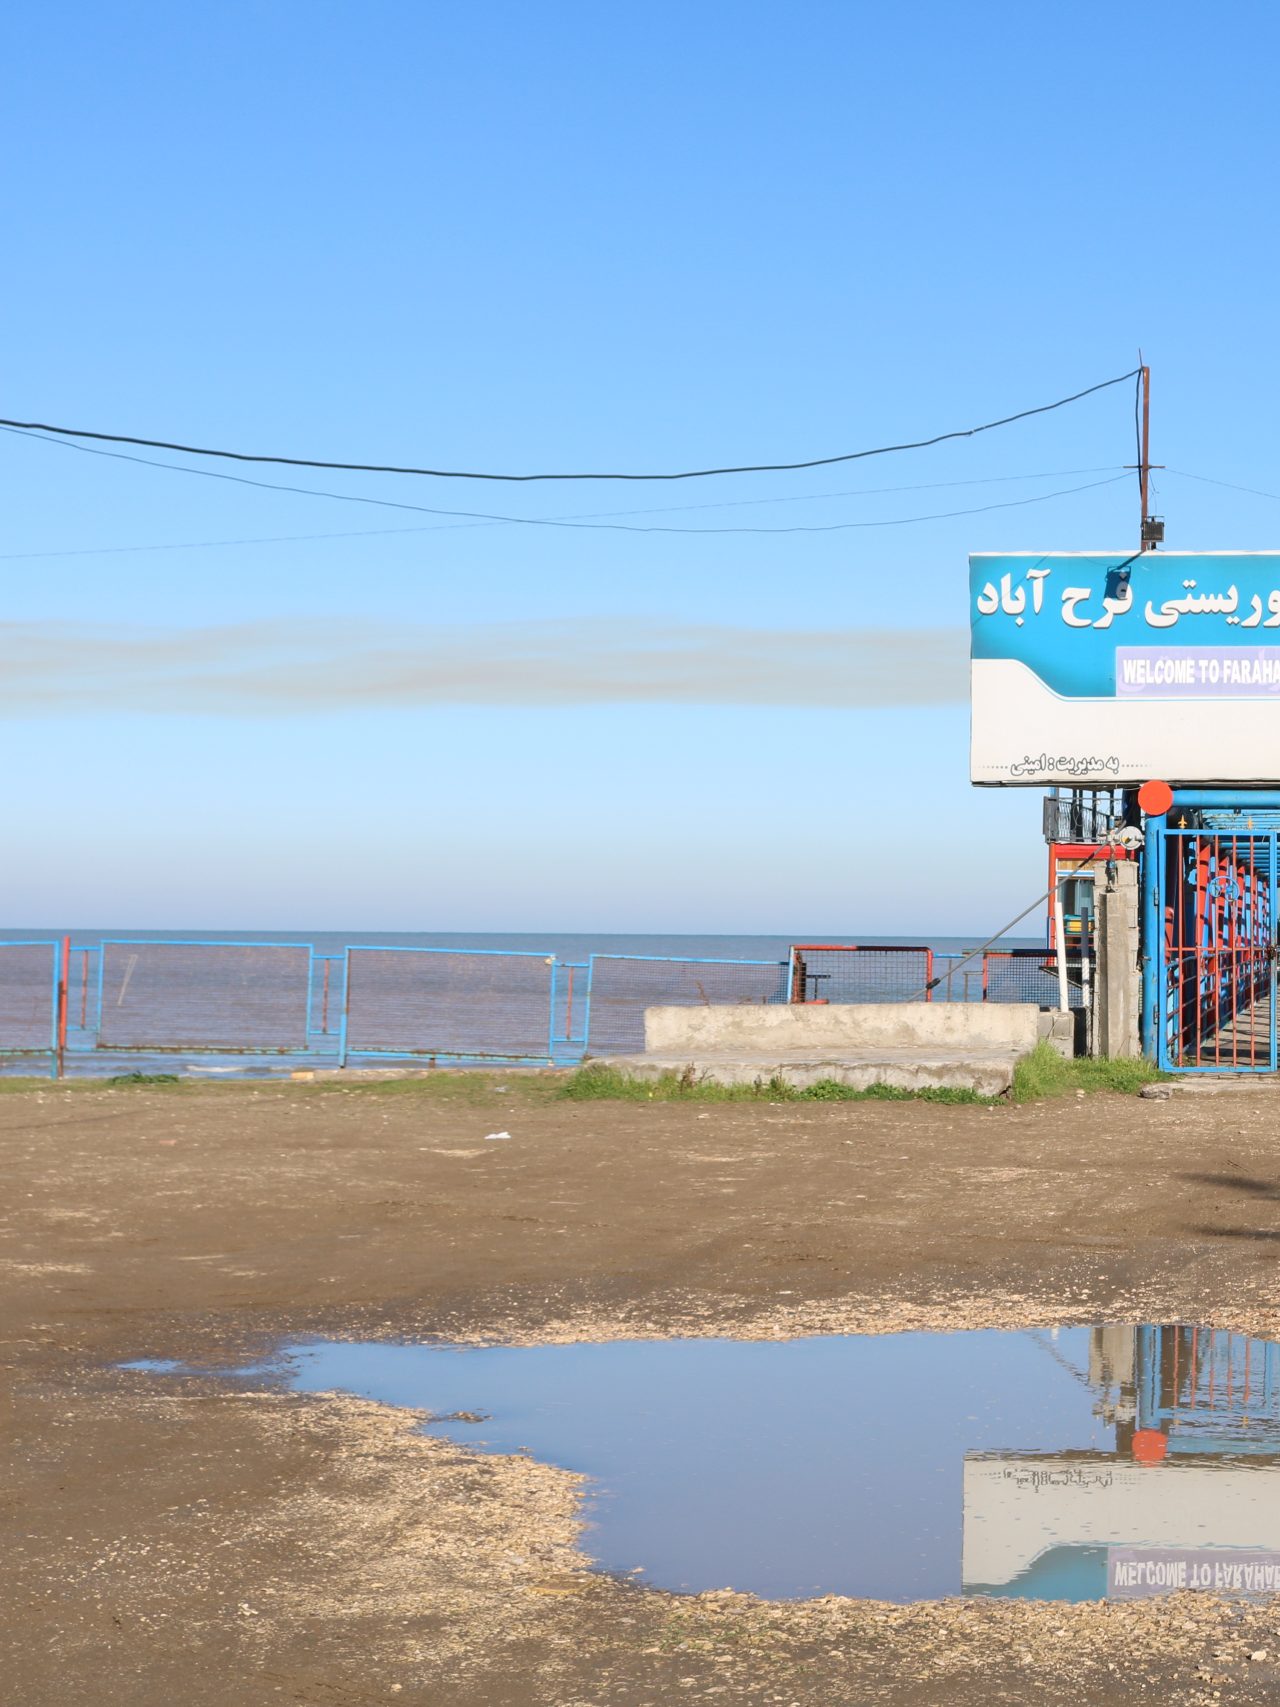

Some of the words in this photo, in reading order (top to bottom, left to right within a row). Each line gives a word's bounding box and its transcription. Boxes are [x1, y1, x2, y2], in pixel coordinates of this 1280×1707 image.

[976, 568, 1051, 627] آباد
[1061, 572, 1133, 628] فرح
[1123, 659, 1196, 685] WELCOME
[1198, 659, 1220, 684] TO
[1010, 753, 1046, 776] امینی
